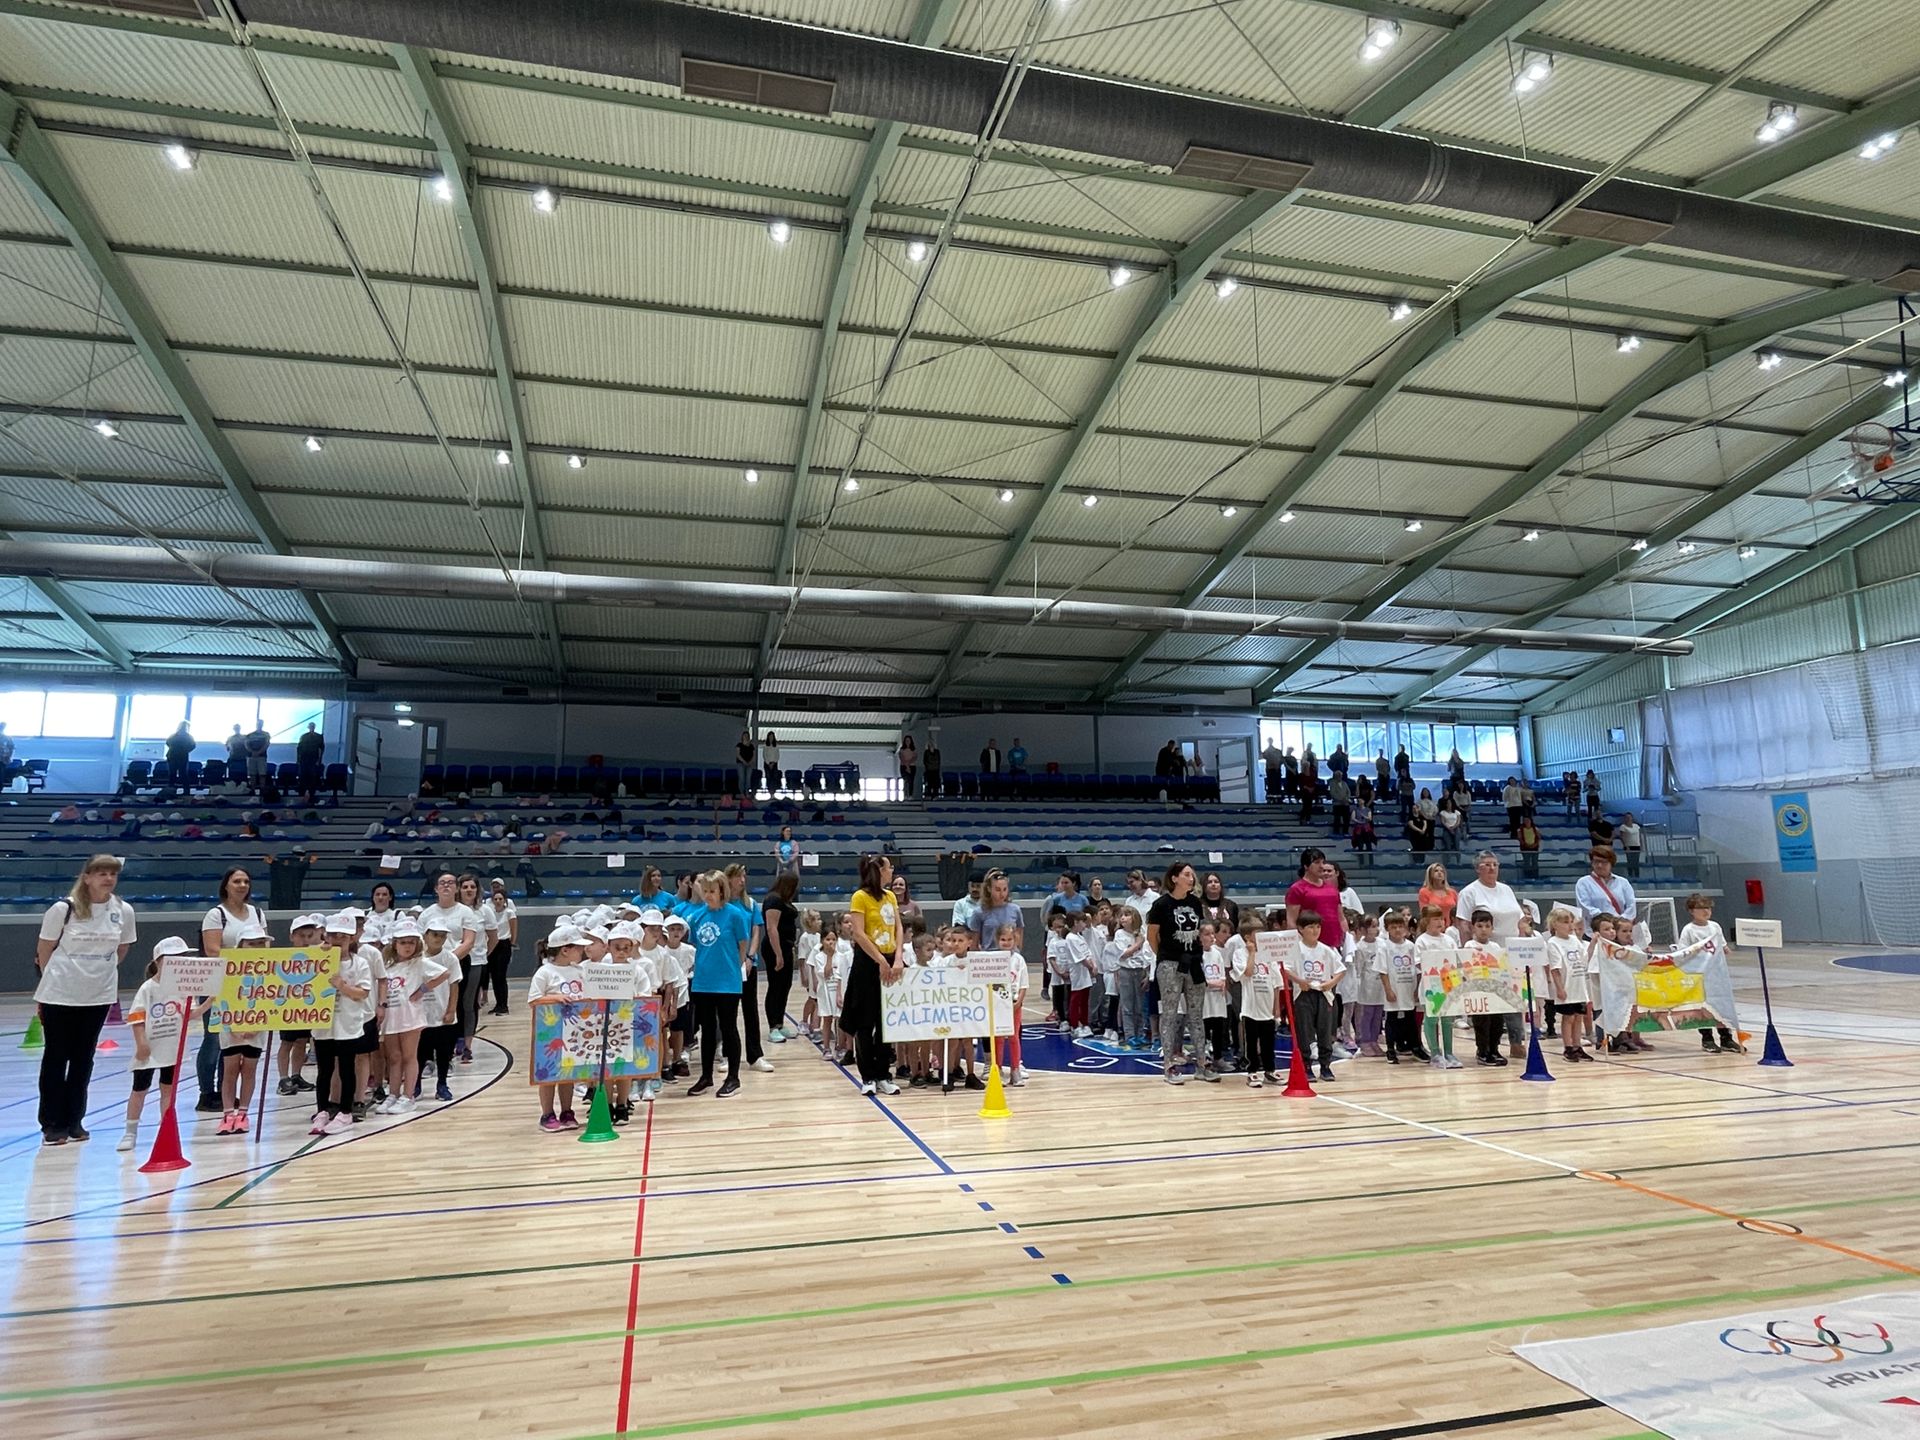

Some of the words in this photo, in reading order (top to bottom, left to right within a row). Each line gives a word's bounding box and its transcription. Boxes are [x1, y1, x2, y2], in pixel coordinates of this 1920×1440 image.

[225, 957, 276, 976] DJEČJI
[246, 984, 313, 1000] JASLICE
[885, 987, 984, 1008] KALIMERO
[1463, 997, 1490, 1013] BUJE
[282, 1007, 331, 1024] UMAG
[886, 1006, 986, 1026] CALIMERO
